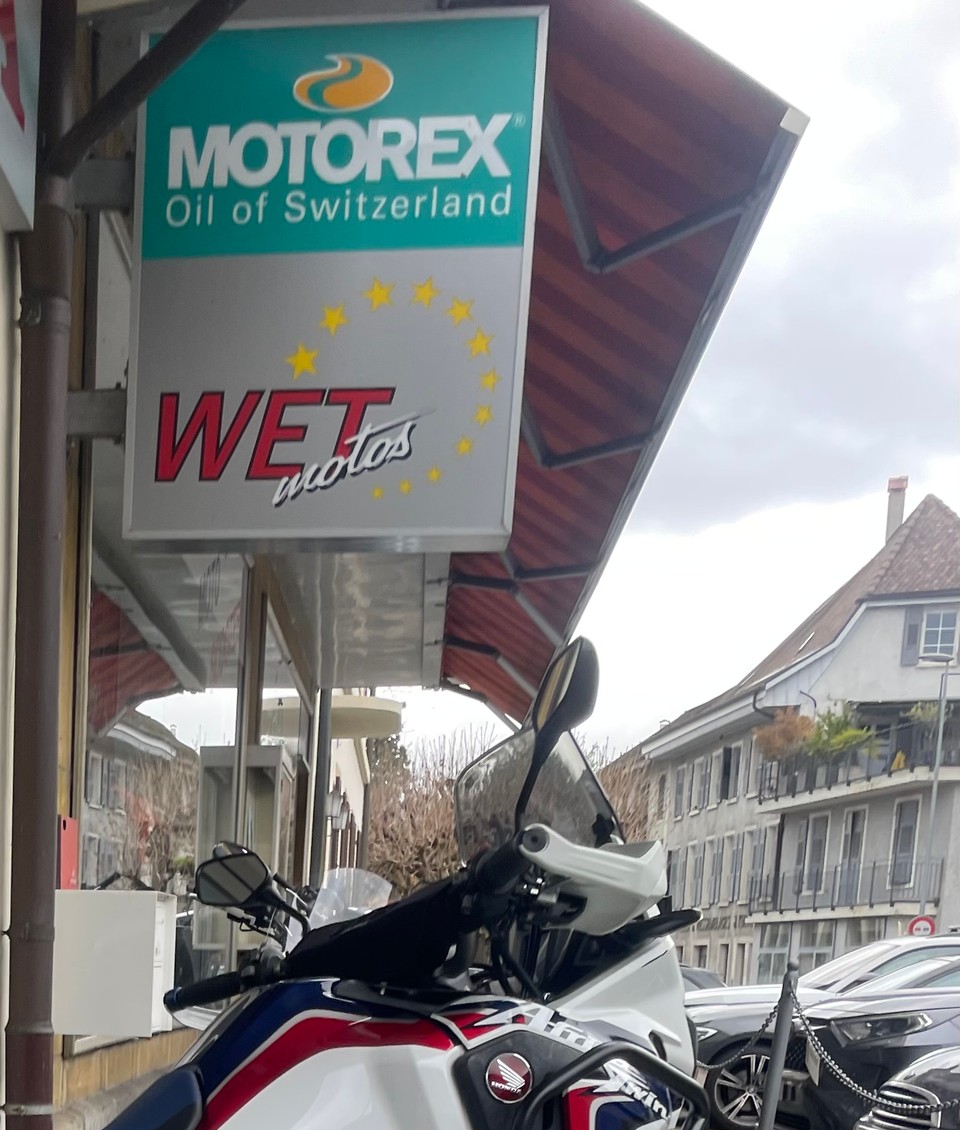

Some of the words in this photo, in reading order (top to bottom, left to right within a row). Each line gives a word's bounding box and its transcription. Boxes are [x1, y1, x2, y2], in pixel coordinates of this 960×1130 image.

[167, 113, 513, 190] MOTOREX
[166, 194, 213, 227] Oil
[233, 191, 268, 224] of
[284, 184, 512, 224] Switzerland
[154, 386, 396, 483] WET
[271, 407, 438, 508] motos
[491, 1081, 522, 1095] HONDA
